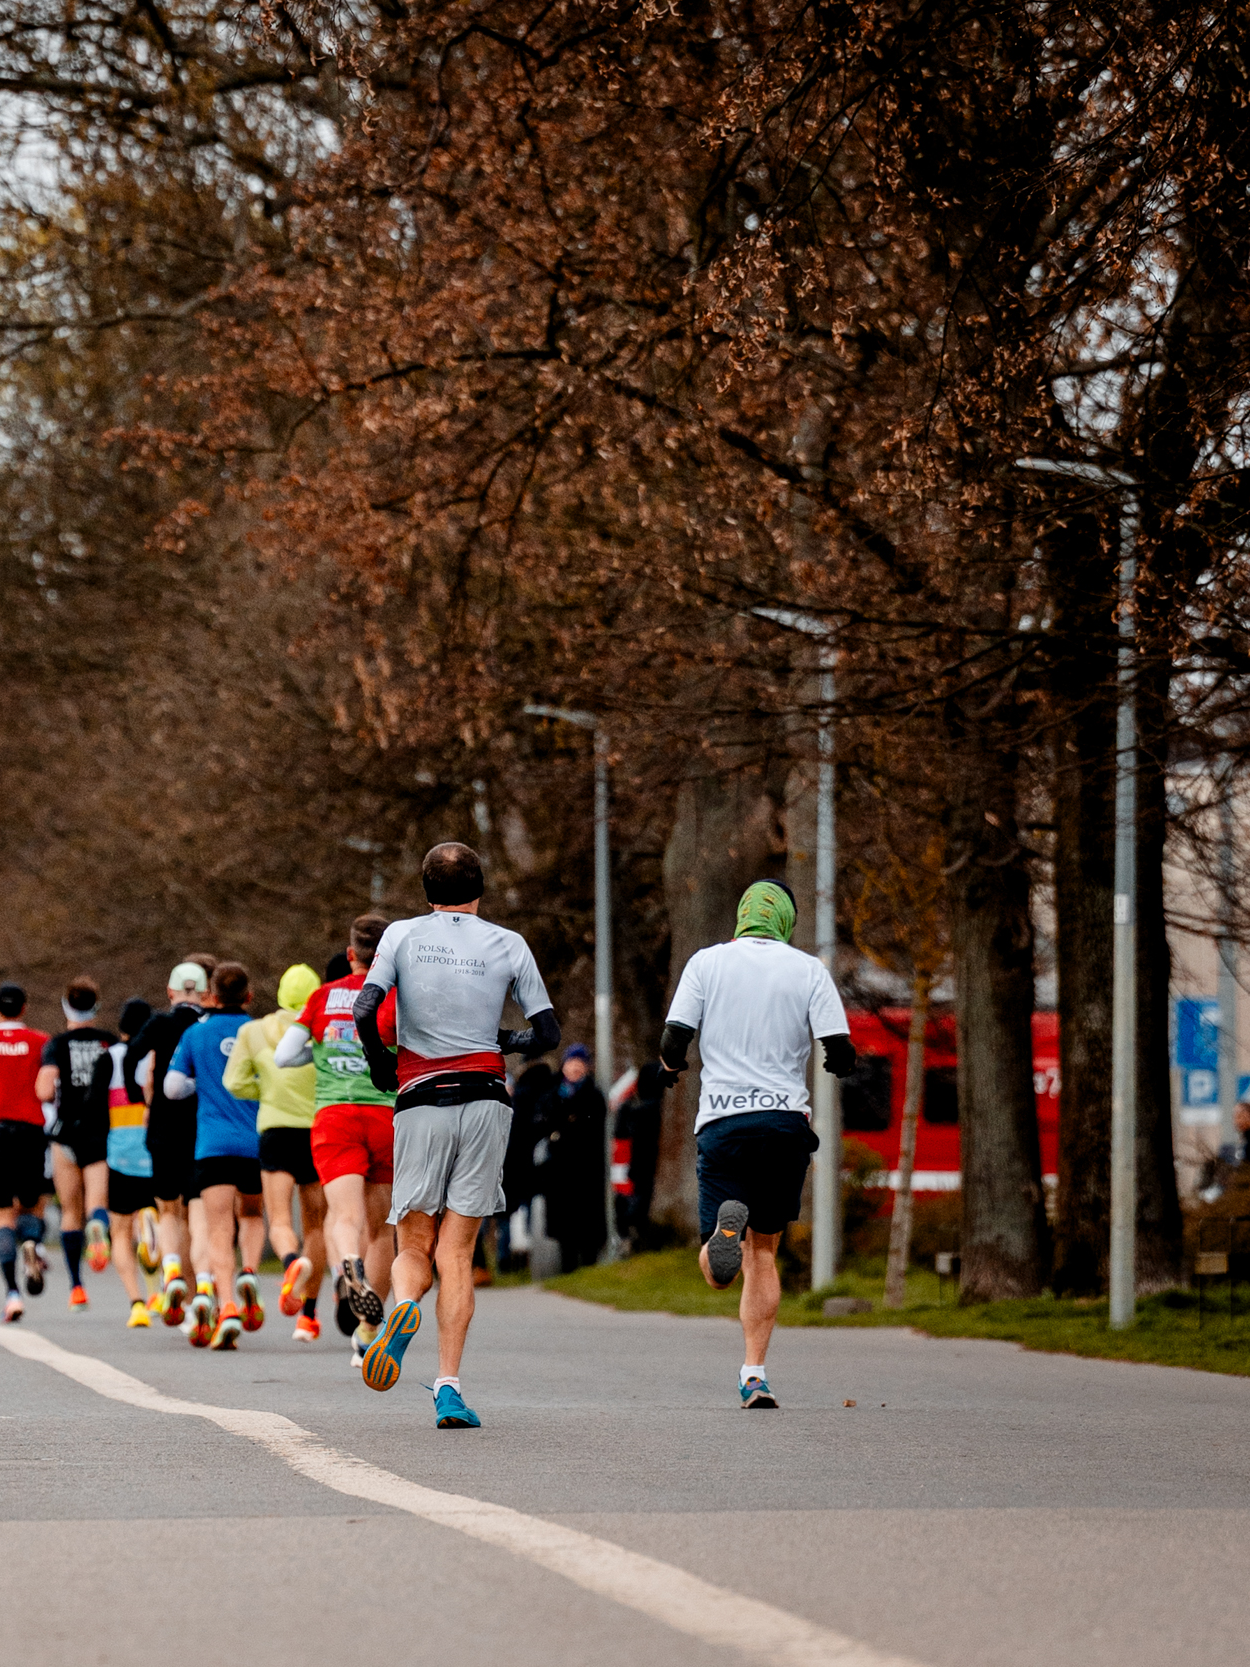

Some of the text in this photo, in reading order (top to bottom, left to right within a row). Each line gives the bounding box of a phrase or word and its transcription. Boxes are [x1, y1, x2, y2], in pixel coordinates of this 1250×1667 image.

[418, 944, 455, 955] POLSKA
[415, 955, 486, 968] NIEPODLEGŁA
[454, 968, 485, 977] 1918-2018
[708, 1089, 790, 1110] wefox
